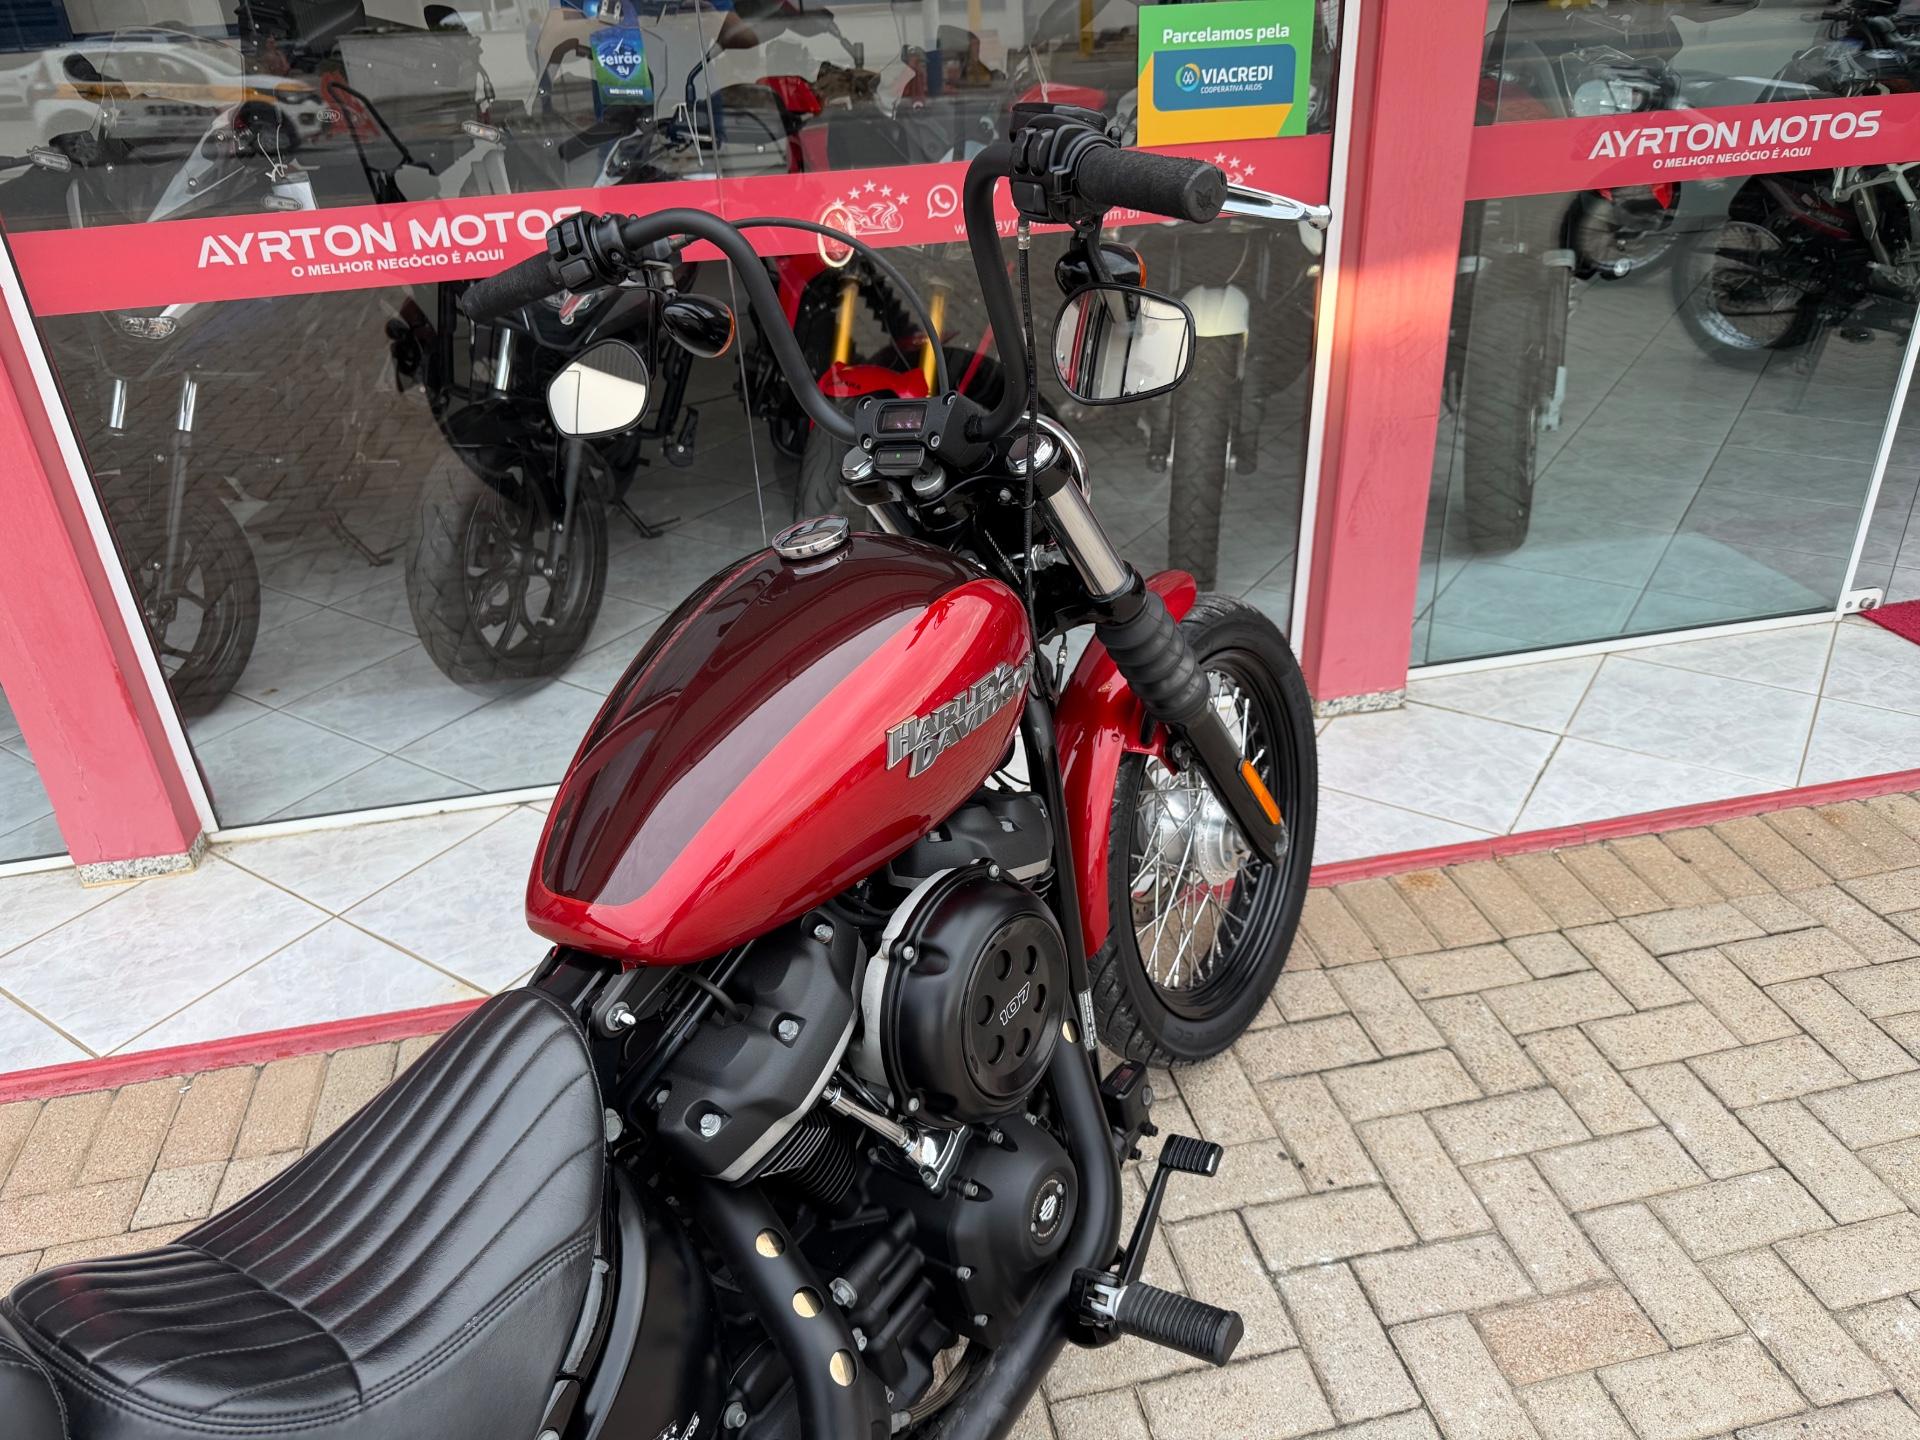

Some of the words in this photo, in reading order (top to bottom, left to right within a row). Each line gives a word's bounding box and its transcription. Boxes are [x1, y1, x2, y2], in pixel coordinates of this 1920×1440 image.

[1163, 27, 1253, 44] Parcelamos
[1256, 23, 1290, 42] pela
[598, 52, 641, 67] Feirão
[1201, 65, 1273, 84] VIACREDI
[1200, 85, 1243, 94] COOPERATIVA
[1244, 83, 1263, 91] AILOS
[1588, 121, 1741, 160] AYRTON
[1749, 110, 1882, 147] MOTOS
[1652, 159, 1664, 169] O
[1665, 154, 1714, 168] MELHOR
[1716, 149, 1770, 163] NEGÓCIO
[1772, 147, 1780, 159] É
[1783, 147, 1812, 157] AQUI
[197, 221, 398, 268] AYRTON
[291, 266, 304, 278] O
[307, 259, 374, 277] MELHOR
[377, 253, 449, 270] NEGÓCIO
[453, 250, 462, 264] É
[464, 248, 505, 262] AQUI
[886, 662, 1014, 770] HARLEY
[999, 981, 1031, 1026] 107
